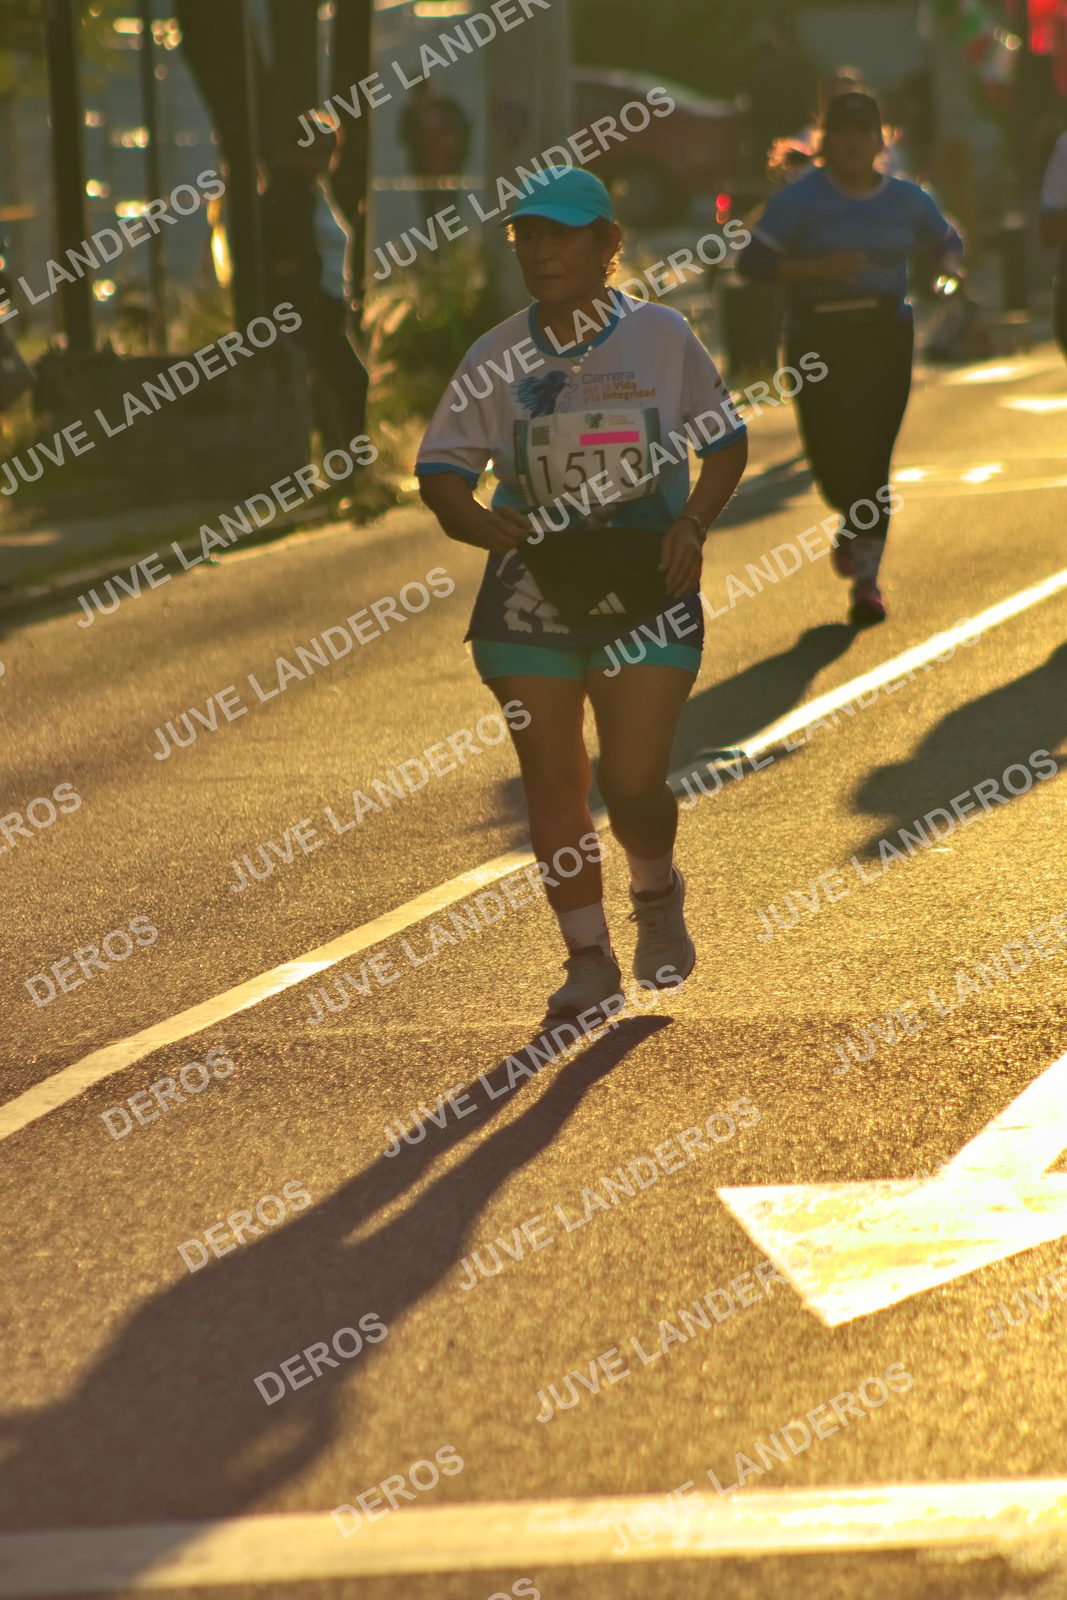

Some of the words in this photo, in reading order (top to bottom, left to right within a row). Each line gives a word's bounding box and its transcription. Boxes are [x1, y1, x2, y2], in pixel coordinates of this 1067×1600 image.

[583, 371, 634, 385] Carrera
[613, 380, 636, 390] Vida
[602, 387, 656, 401] Integridad
[537, 447, 642, 494] 1513
